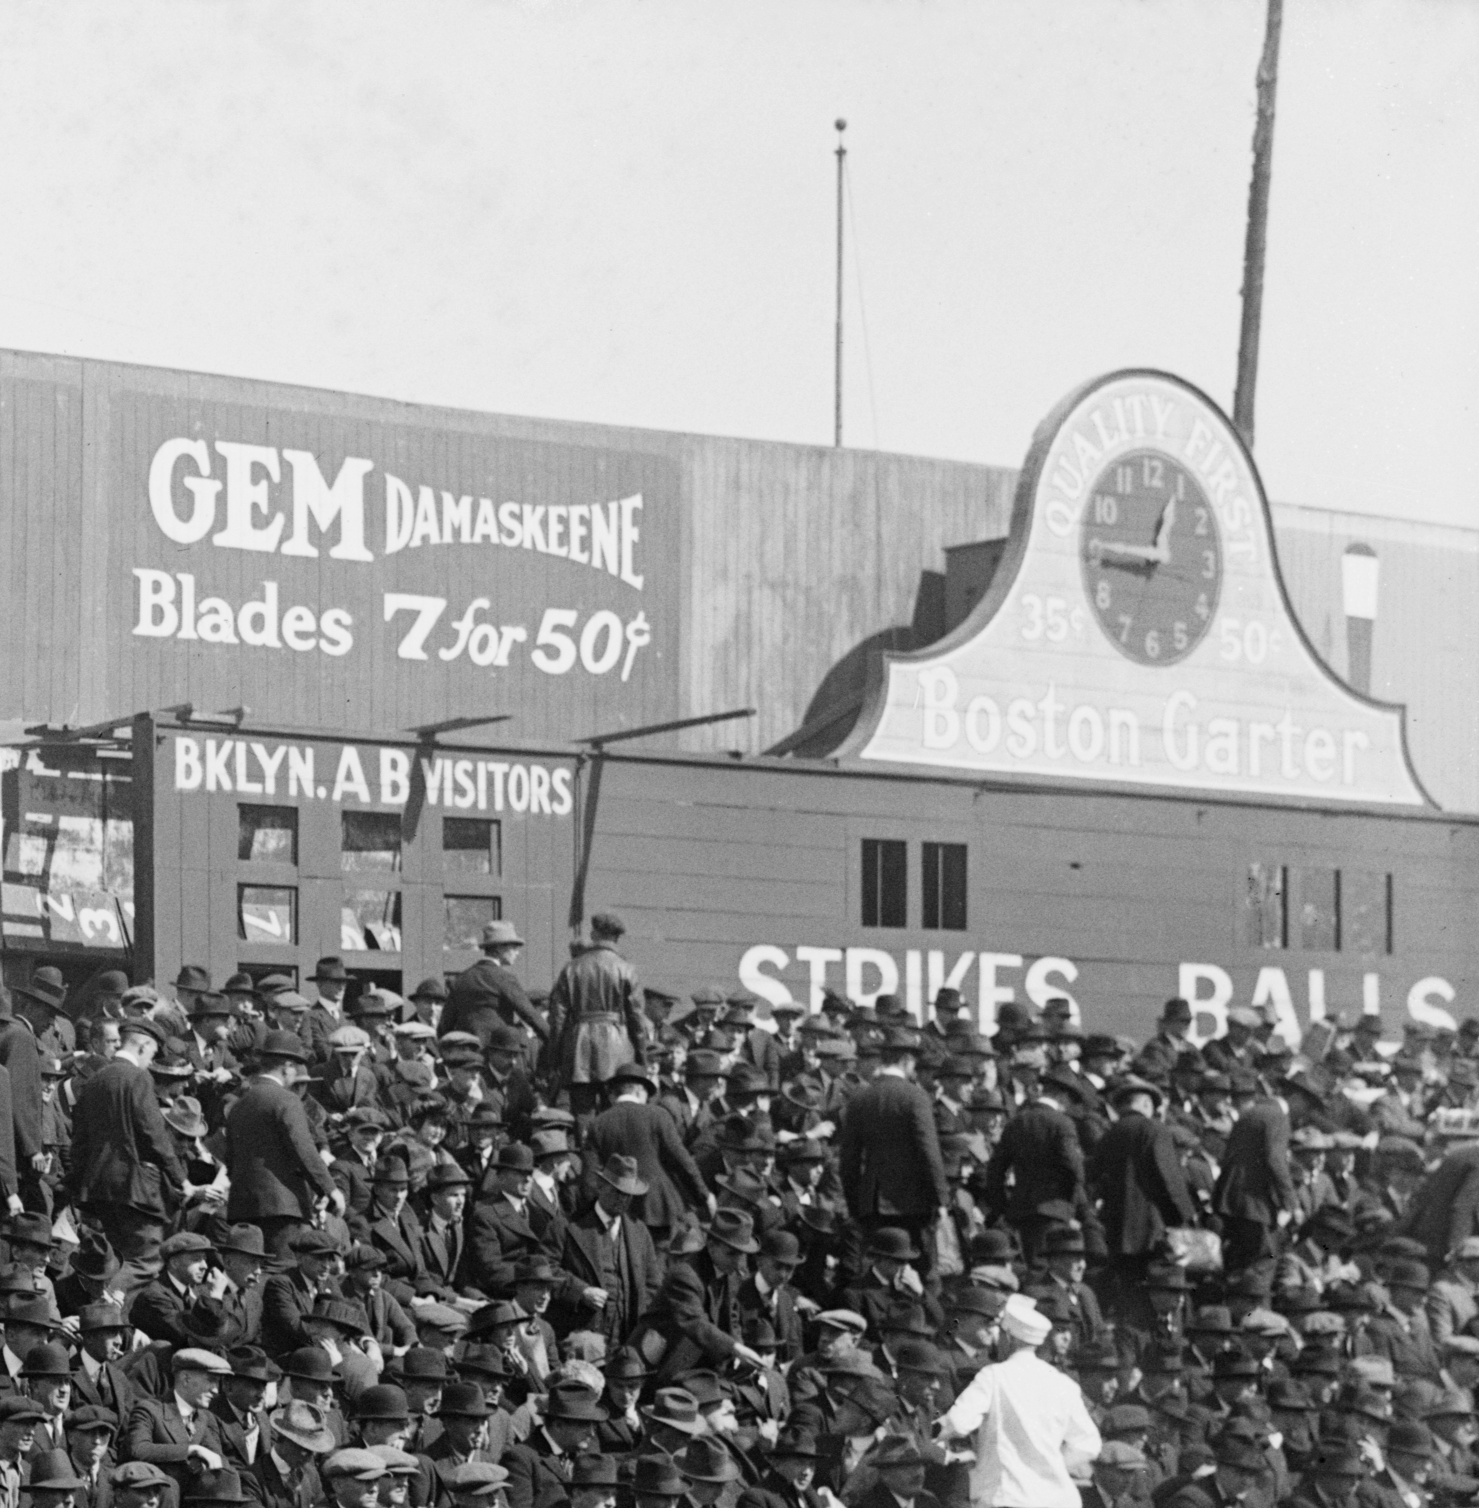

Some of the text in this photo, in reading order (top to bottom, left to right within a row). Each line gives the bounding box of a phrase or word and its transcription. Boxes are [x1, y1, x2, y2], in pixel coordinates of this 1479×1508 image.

[1045, 393, 1257, 561] QUALITY FIRST
[1116, 466, 1133, 495] 11
[1143, 458, 1164, 489] 12
[148, 437, 644, 591] GEM DAMASKEENE
[1094, 495, 1118, 525] 10
[1194, 507, 1208, 535] 2
[1201, 549, 1215, 580] 3
[1095, 580, 1111, 611] 8
[1195, 592, 1209, 622] 4
[131, 567, 651, 682] Blades 7 for 50¢
[1021, 591, 1085, 642] 35¢
[1118, 614, 1133, 643] 7
[1145, 628, 1160, 659] 6
[1173, 620, 1188, 651] 5
[1219, 616, 1284, 665] 50¢
[916, 663, 1369, 785] Boston Garter
[174, 736, 328, 800] BKLYN.
[420, 757, 573, 815] VISITORS
